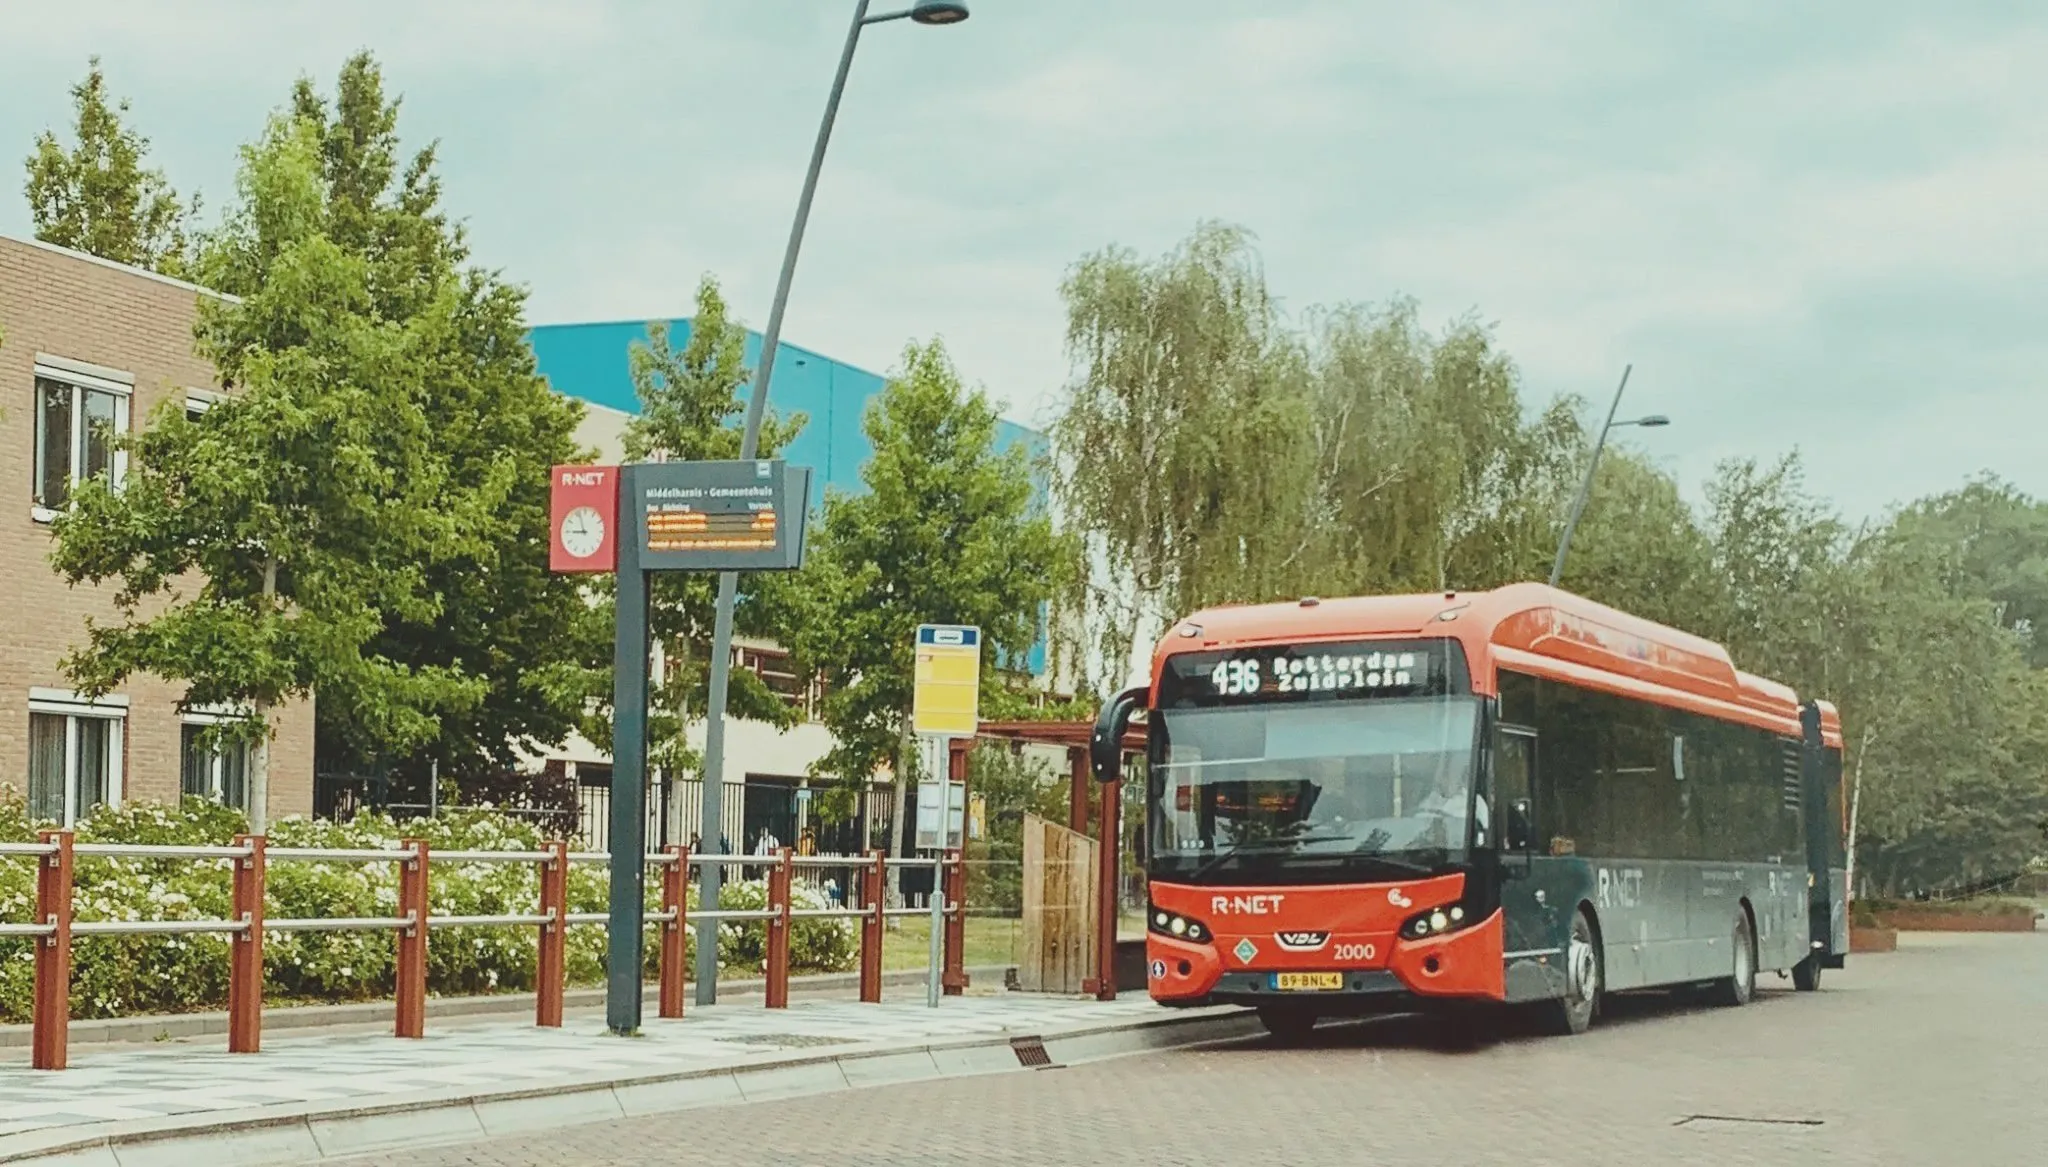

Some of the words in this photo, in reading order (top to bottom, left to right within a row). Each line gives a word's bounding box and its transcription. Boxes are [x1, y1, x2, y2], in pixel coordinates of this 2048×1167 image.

[646, 488, 702, 498] Middelharnis
[709, 486, 773, 497] Gemeentehuis
[1212, 658, 1260, 695] 436
[1284, 933, 1321, 945] VDL
[1334, 944, 1375, 960] 2000
[1281, 974, 1338, 987] 89-BNL-4
